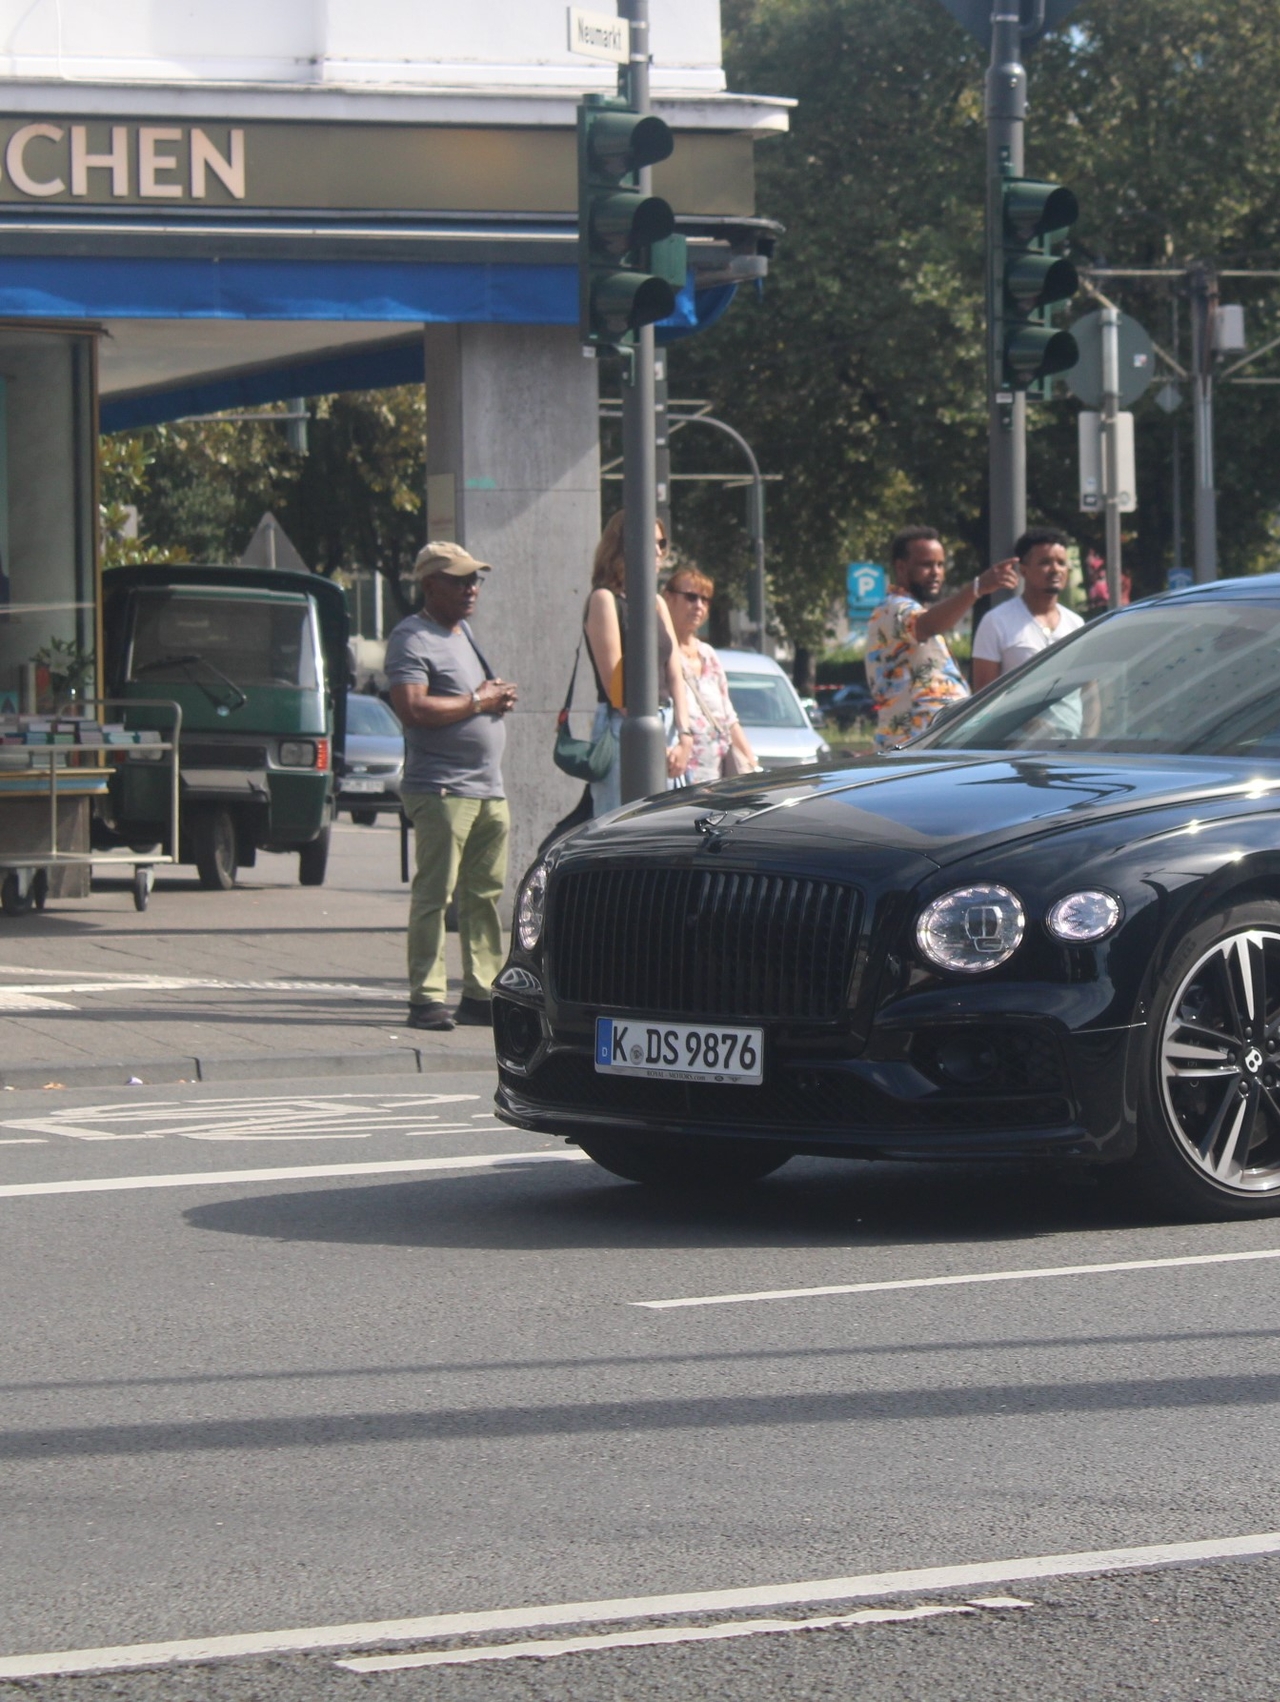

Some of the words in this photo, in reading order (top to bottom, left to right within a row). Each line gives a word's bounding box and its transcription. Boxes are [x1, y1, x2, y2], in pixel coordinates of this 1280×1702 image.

[577, 16, 621, 51] Neumarkt
[0, 123, 246, 200] CHEN
[612, 1025, 629, 1062] K
[645, 1028, 679, 1065] DS
[685, 1031, 757, 1071] 9876
